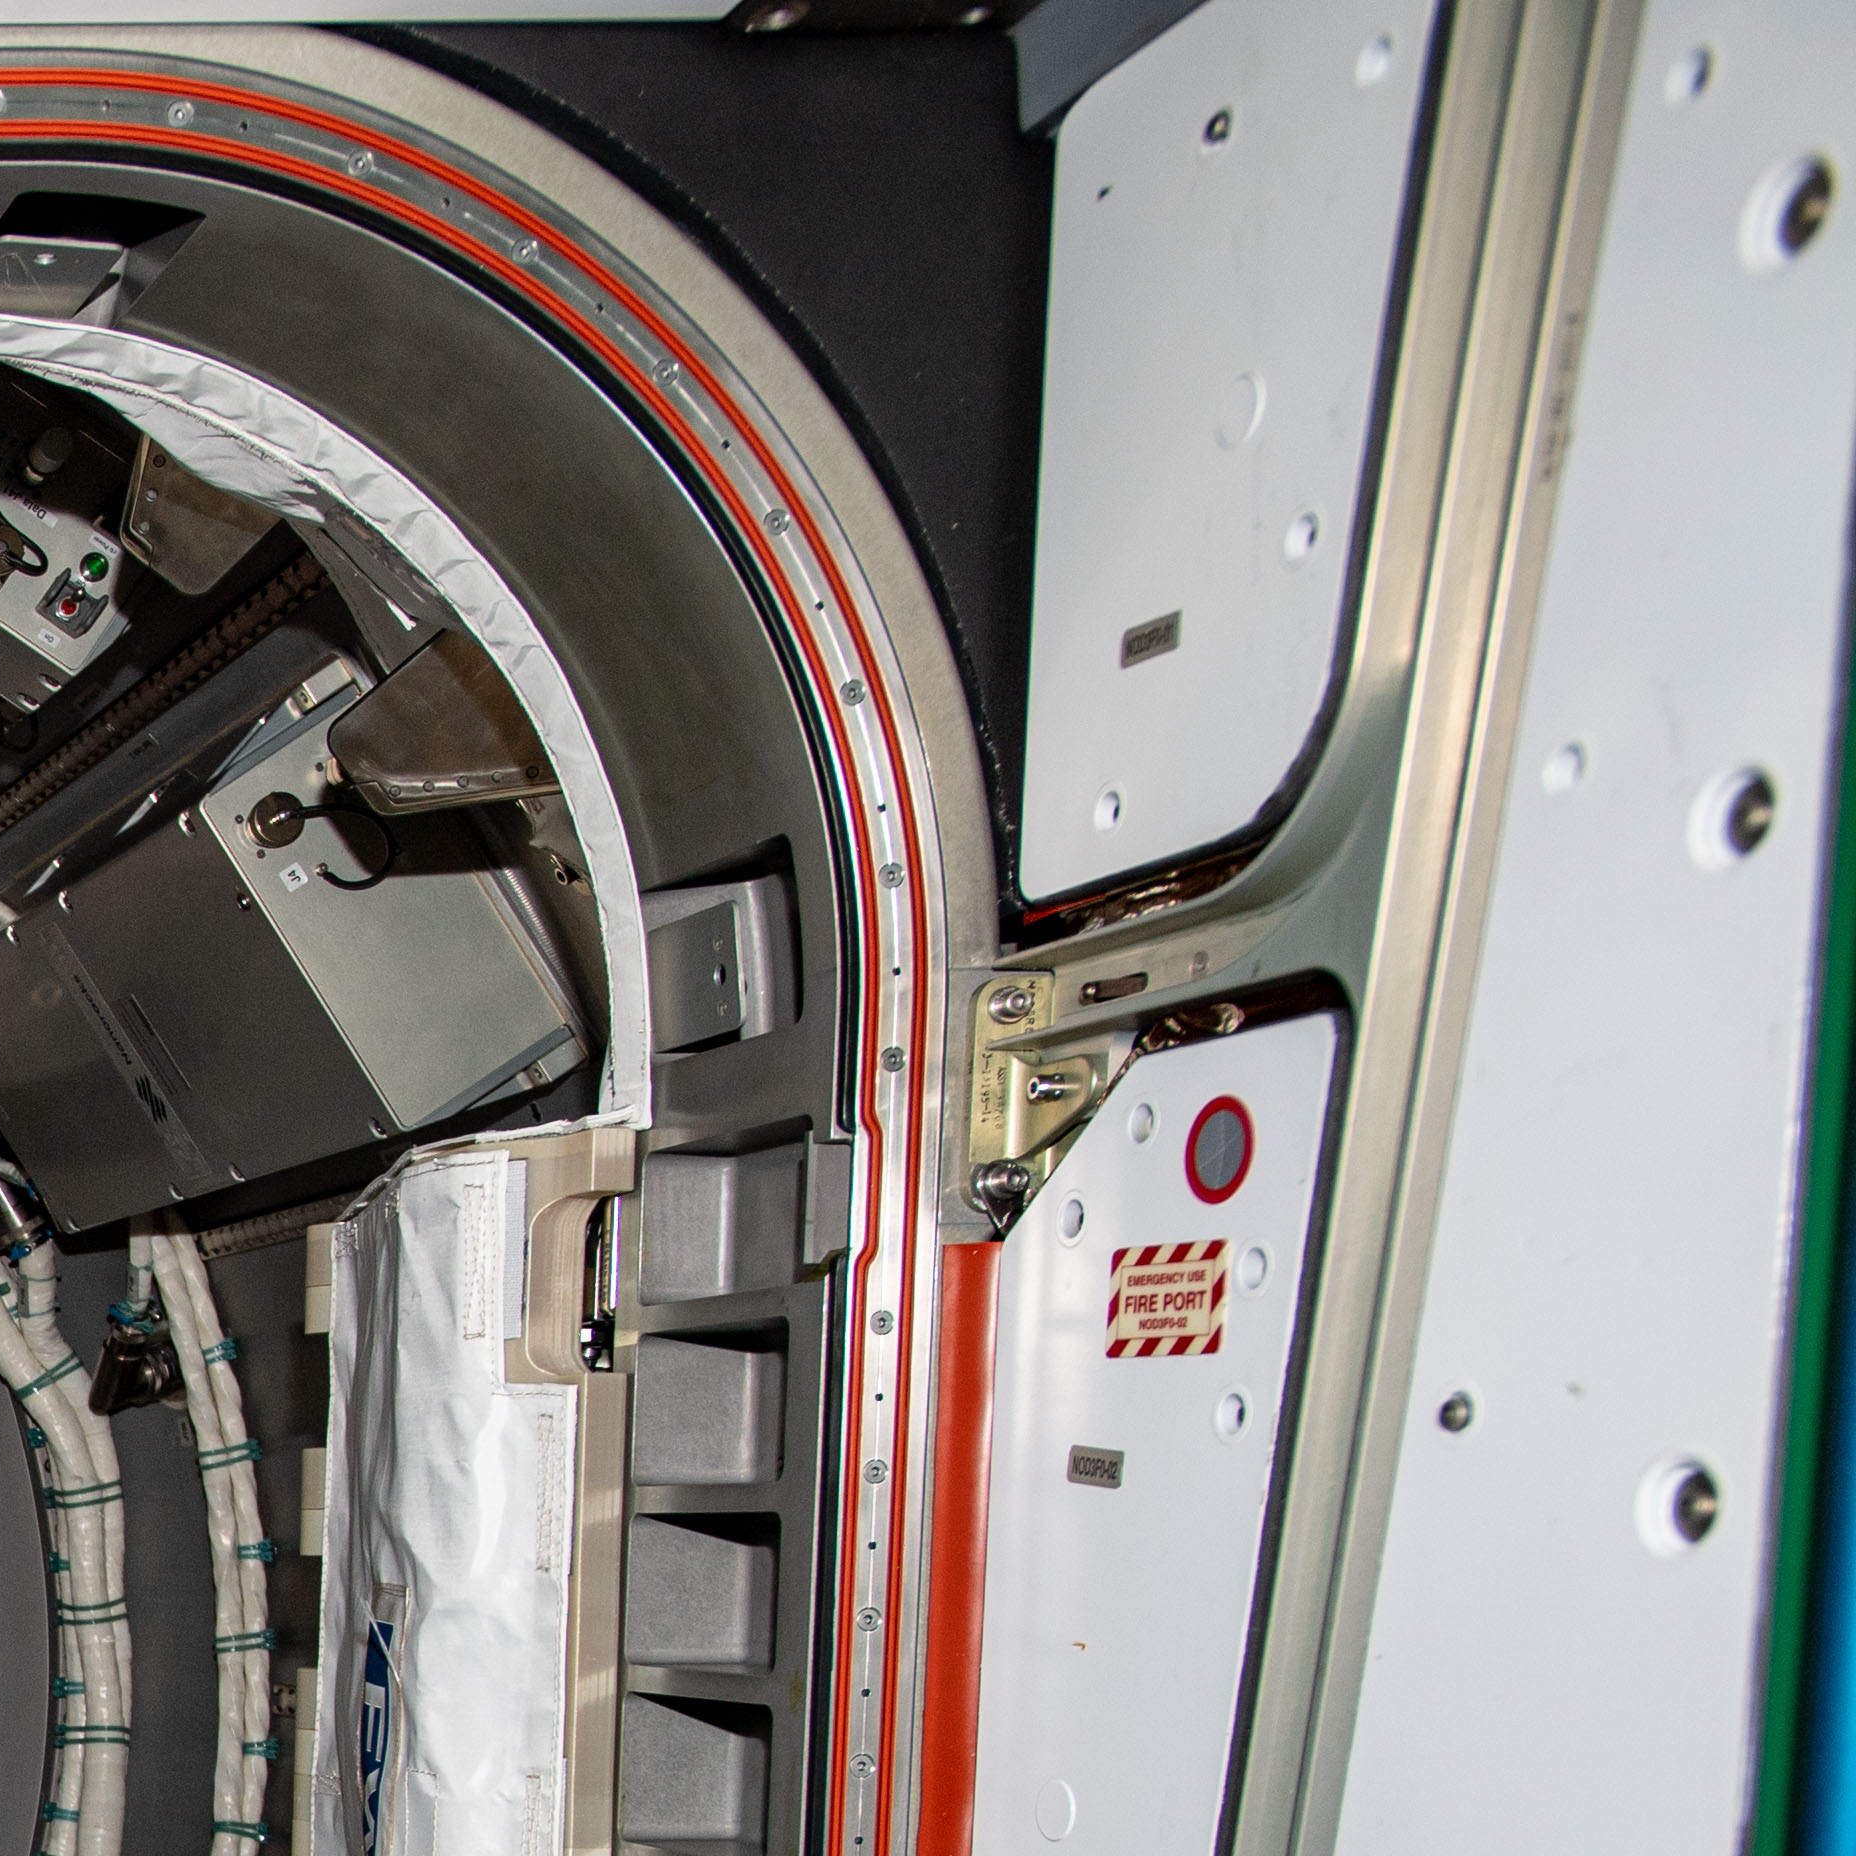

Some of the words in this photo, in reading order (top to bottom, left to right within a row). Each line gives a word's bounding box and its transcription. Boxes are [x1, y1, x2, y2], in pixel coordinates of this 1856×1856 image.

[1, 483, 24, 504] J41
[20, 496, 47, 520] Data
[90, 533, 111, 551] Power
[41, 631, 55, 644] On
[286, 869, 301, 883] J4
[74, 974, 134, 1067] Nanoracks
[1127, 1271, 1185, 1287] EMERGENCY
[1188, 1269, 1207, 1282] USE
[1124, 1294, 1158, 1314] FIRE
[1163, 1290, 1207, 1311] PORT
